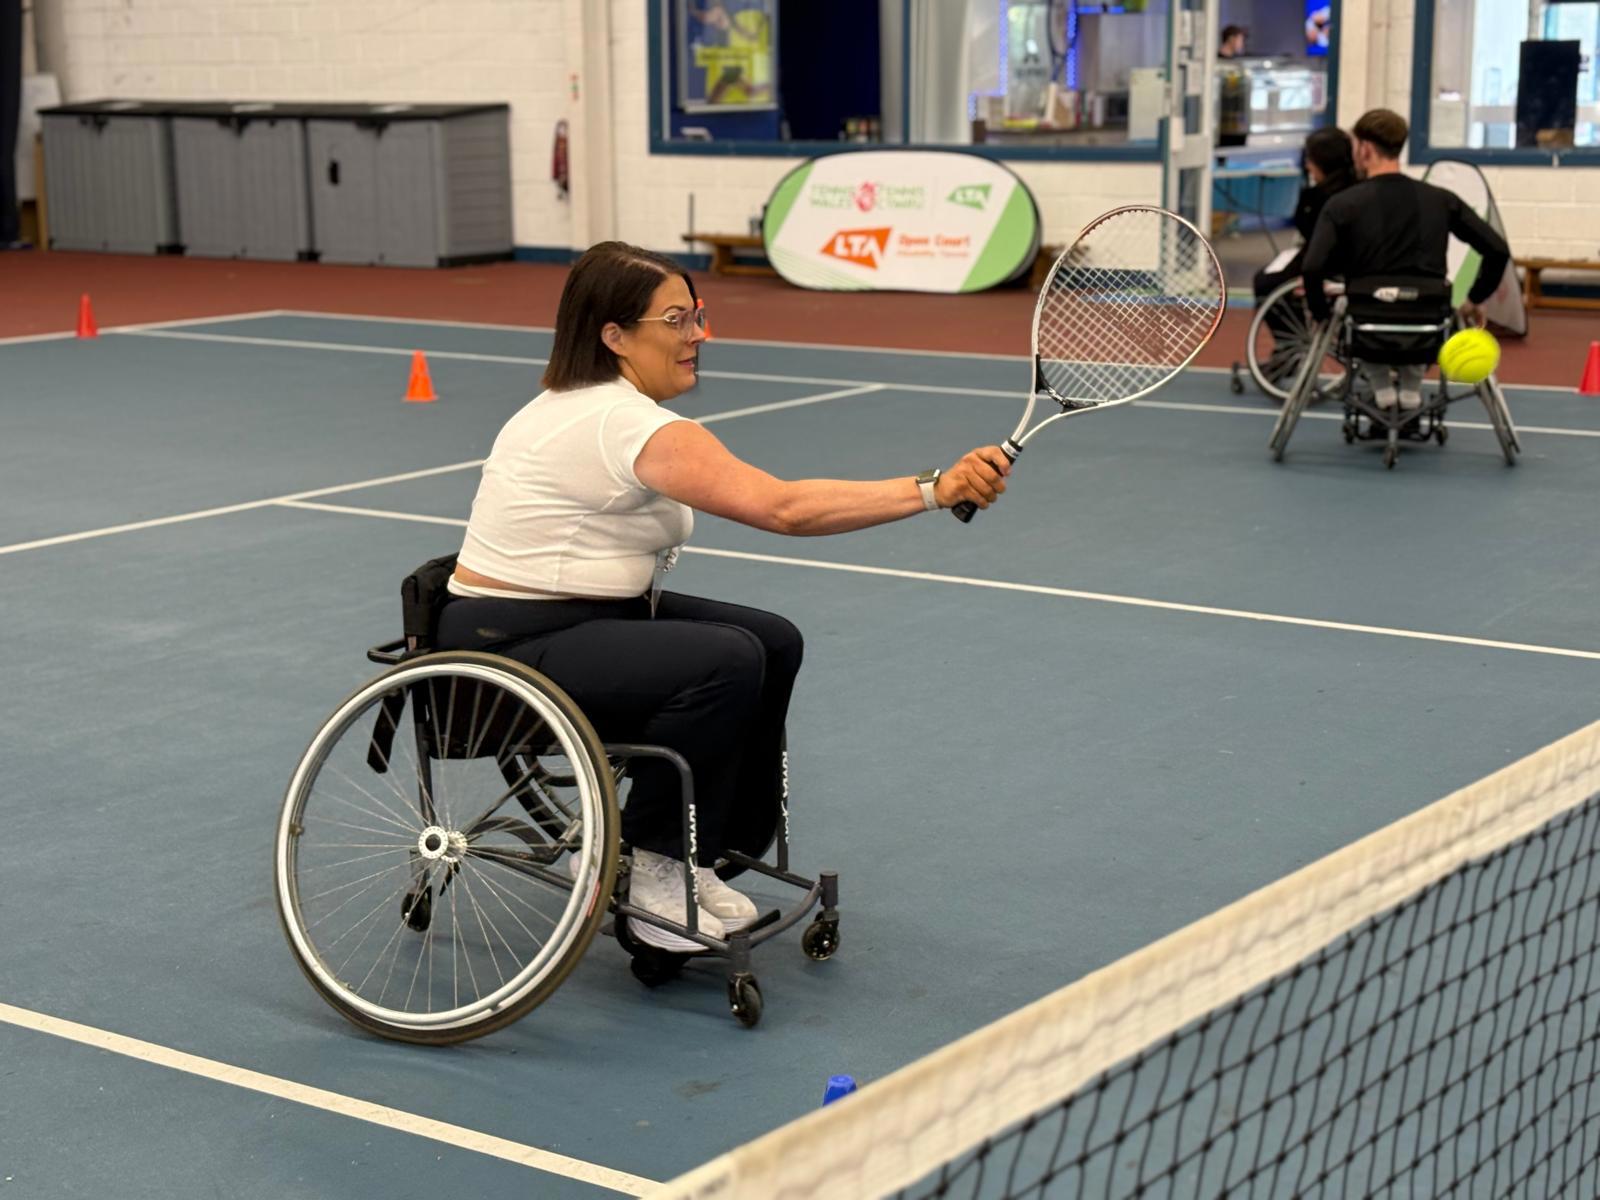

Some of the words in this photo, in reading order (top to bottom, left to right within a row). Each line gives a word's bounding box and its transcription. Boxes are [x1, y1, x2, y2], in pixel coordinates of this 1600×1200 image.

[951, 188, 988, 202] LTA
[833, 233, 884, 258] LTA
[899, 235, 930, 248] Open
[935, 234, 970, 247] Court
